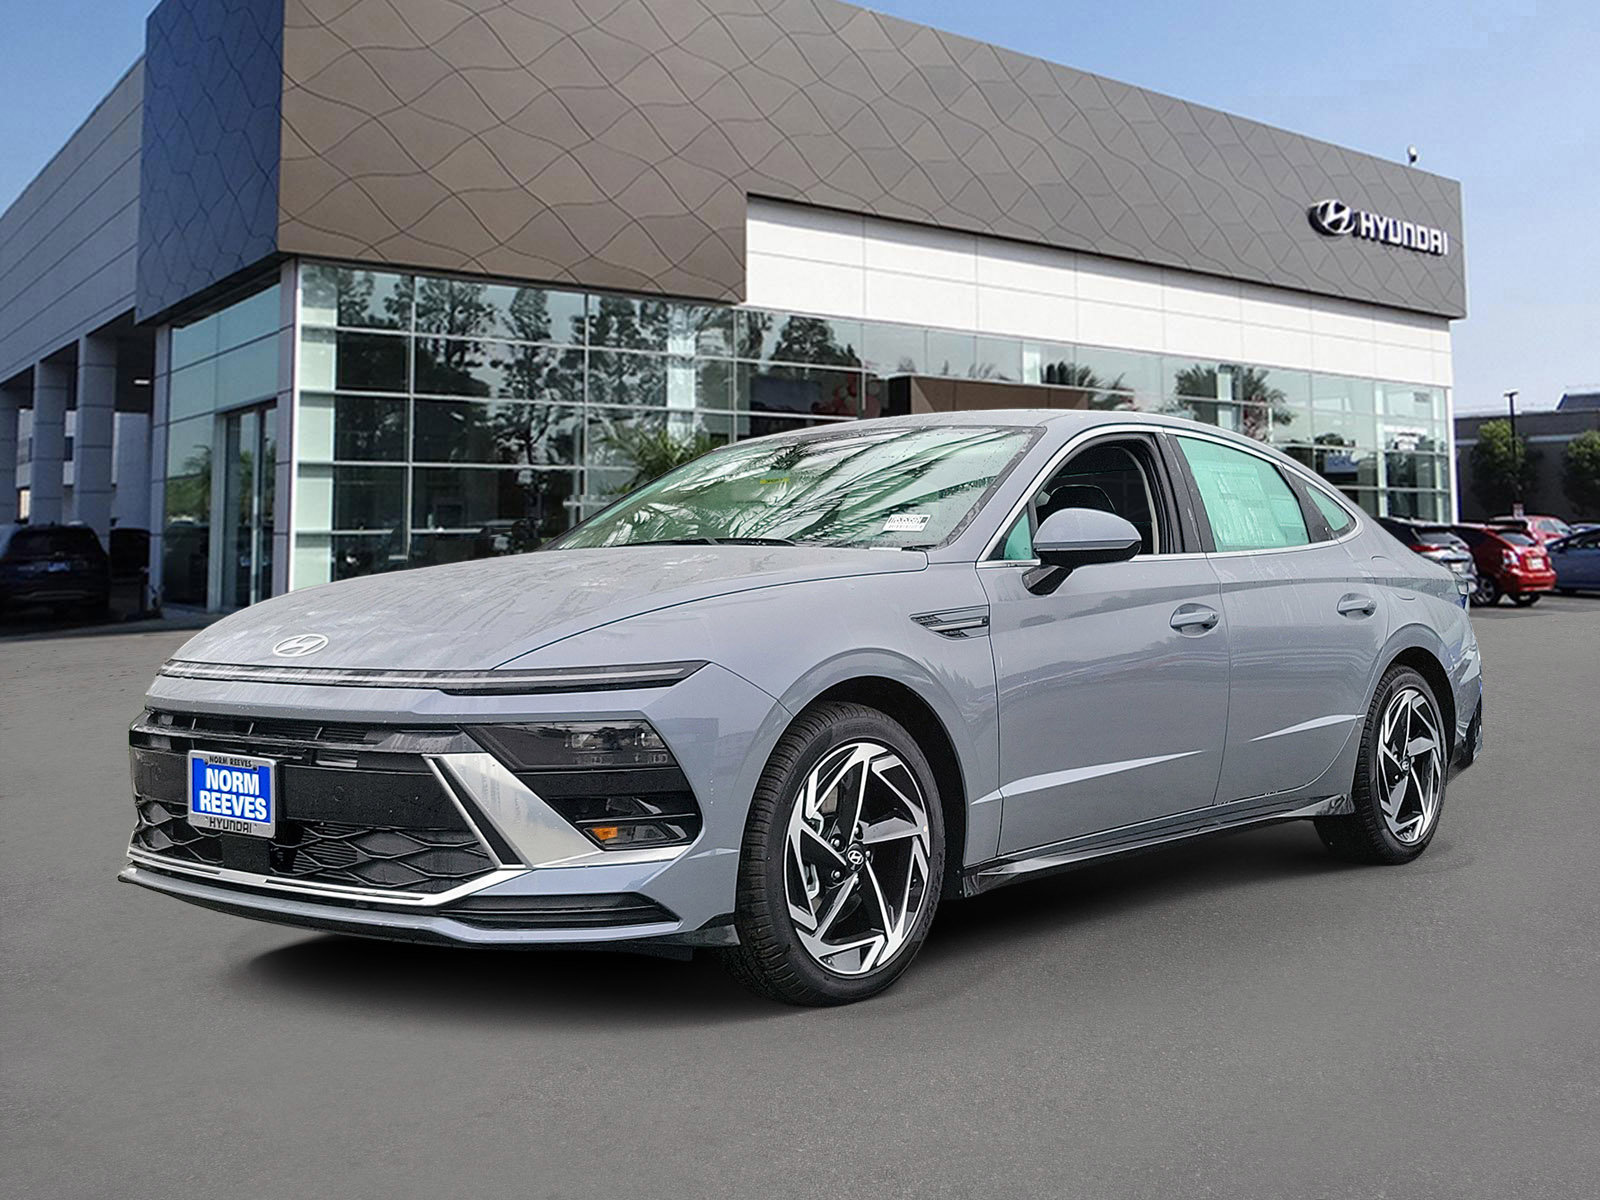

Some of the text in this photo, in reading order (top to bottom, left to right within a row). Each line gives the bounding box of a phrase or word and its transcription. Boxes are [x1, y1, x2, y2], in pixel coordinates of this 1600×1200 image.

[1360, 211, 1448, 255] HYUNDAI
[209, 756, 252, 767] NORM REEVES
[206, 768, 259, 795] NORM
[199, 790, 267, 820] REEVES
[209, 817, 252, 833] HYUNDAI
